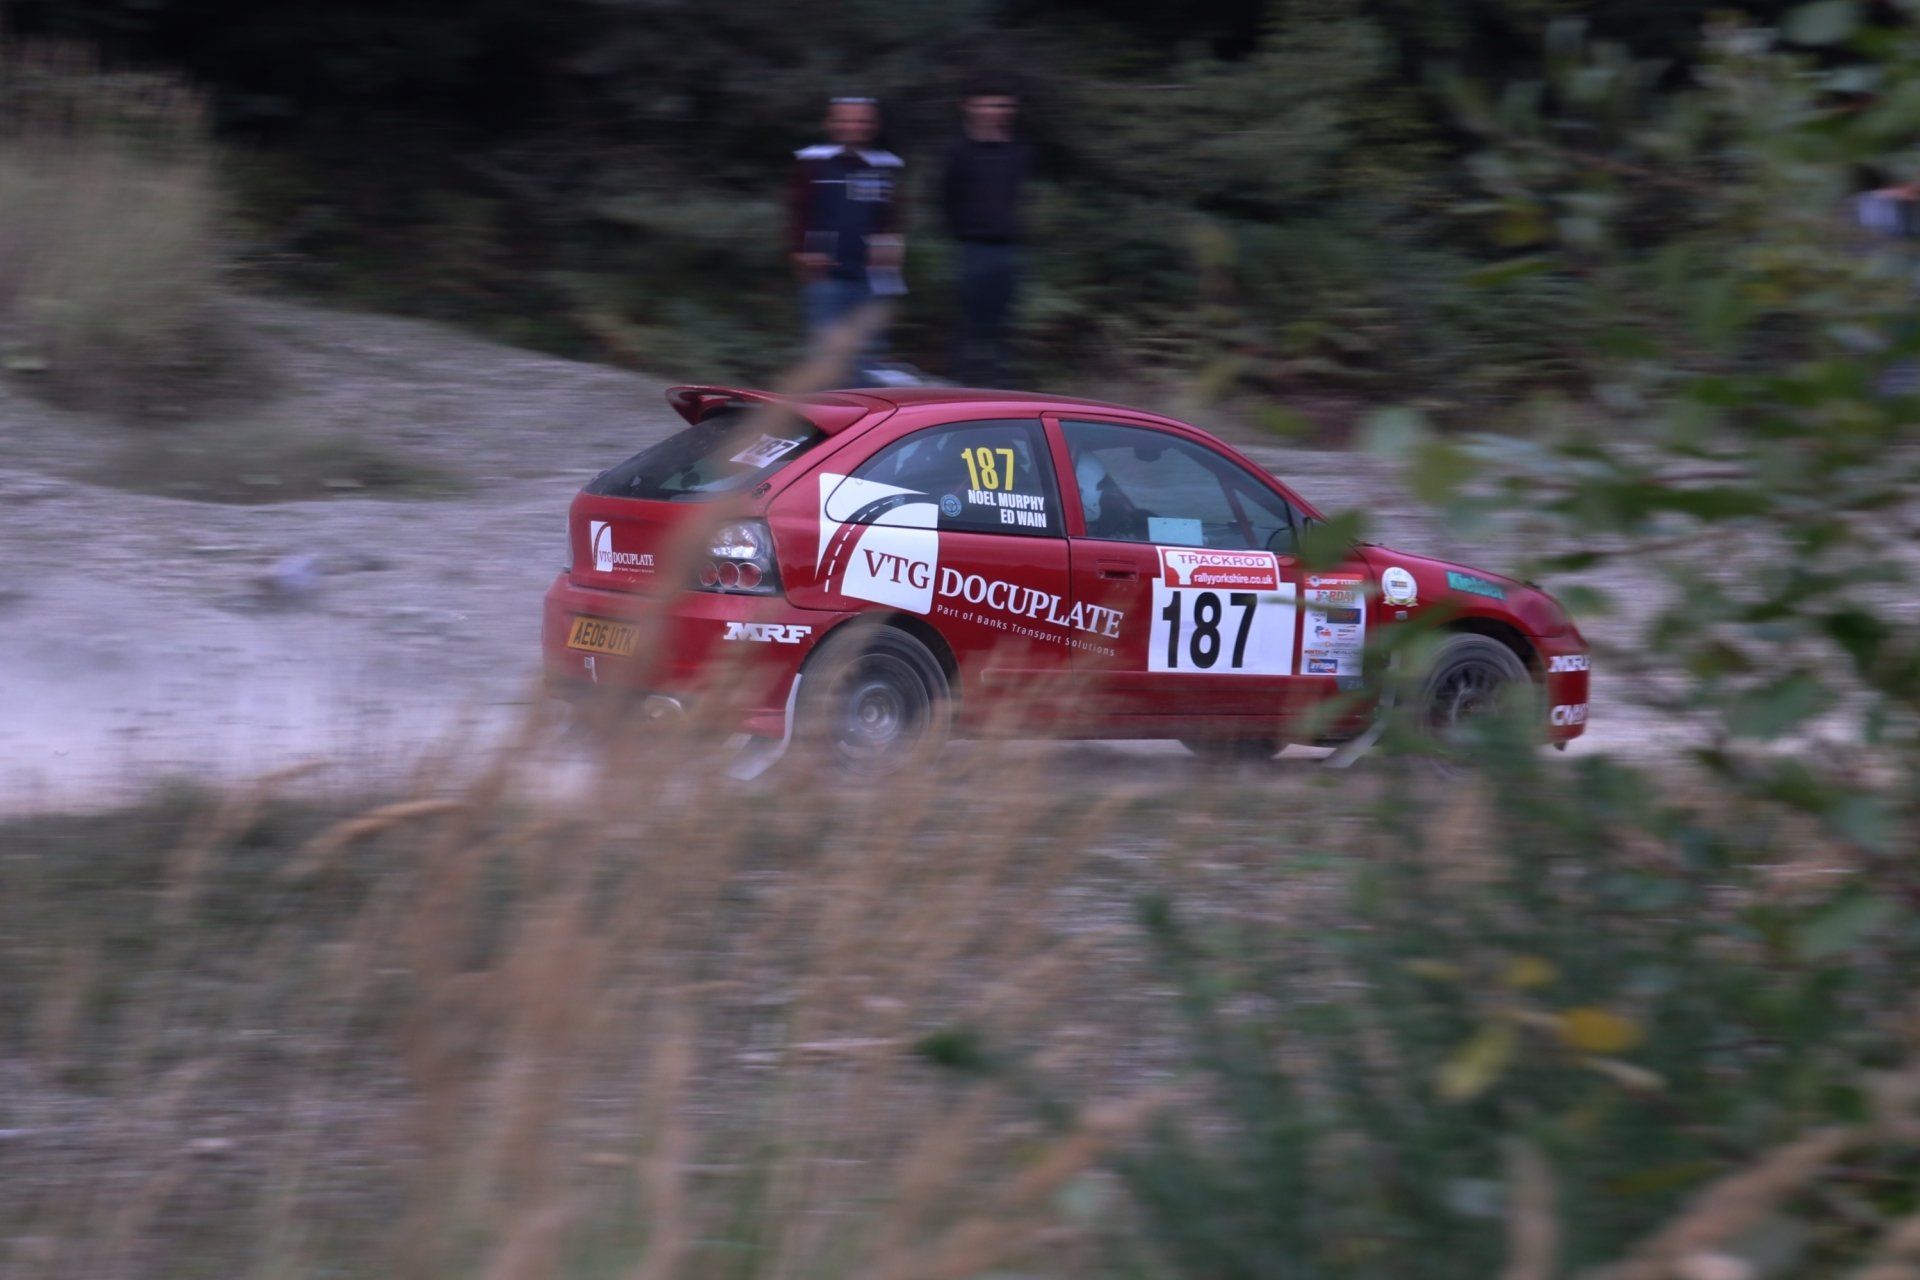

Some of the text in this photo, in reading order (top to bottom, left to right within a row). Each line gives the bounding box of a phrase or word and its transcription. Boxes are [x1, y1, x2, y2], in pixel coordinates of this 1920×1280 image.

[961, 447, 1014, 491] 187
[968, 489, 997, 506] NOEL
[998, 492, 1044, 511] MURPHY
[1000, 508, 1047, 528] ED WAIN
[598, 550, 655, 567] VTG DOCUPLATE
[1178, 554, 1266, 567] TRACKROD
[1194, 573, 1273, 585] rallyyorkshire.co.uk
[863, 549, 1124, 638] VTG DOCUPLATE
[723, 622, 812, 644] MRF
[962, 611, 974, 622] of
[976, 615, 1008, 630] Banks
[1011, 623, 1062, 643] Transport
[1065, 636, 1116, 657] Solutions
[1163, 591, 1257, 668] 187
